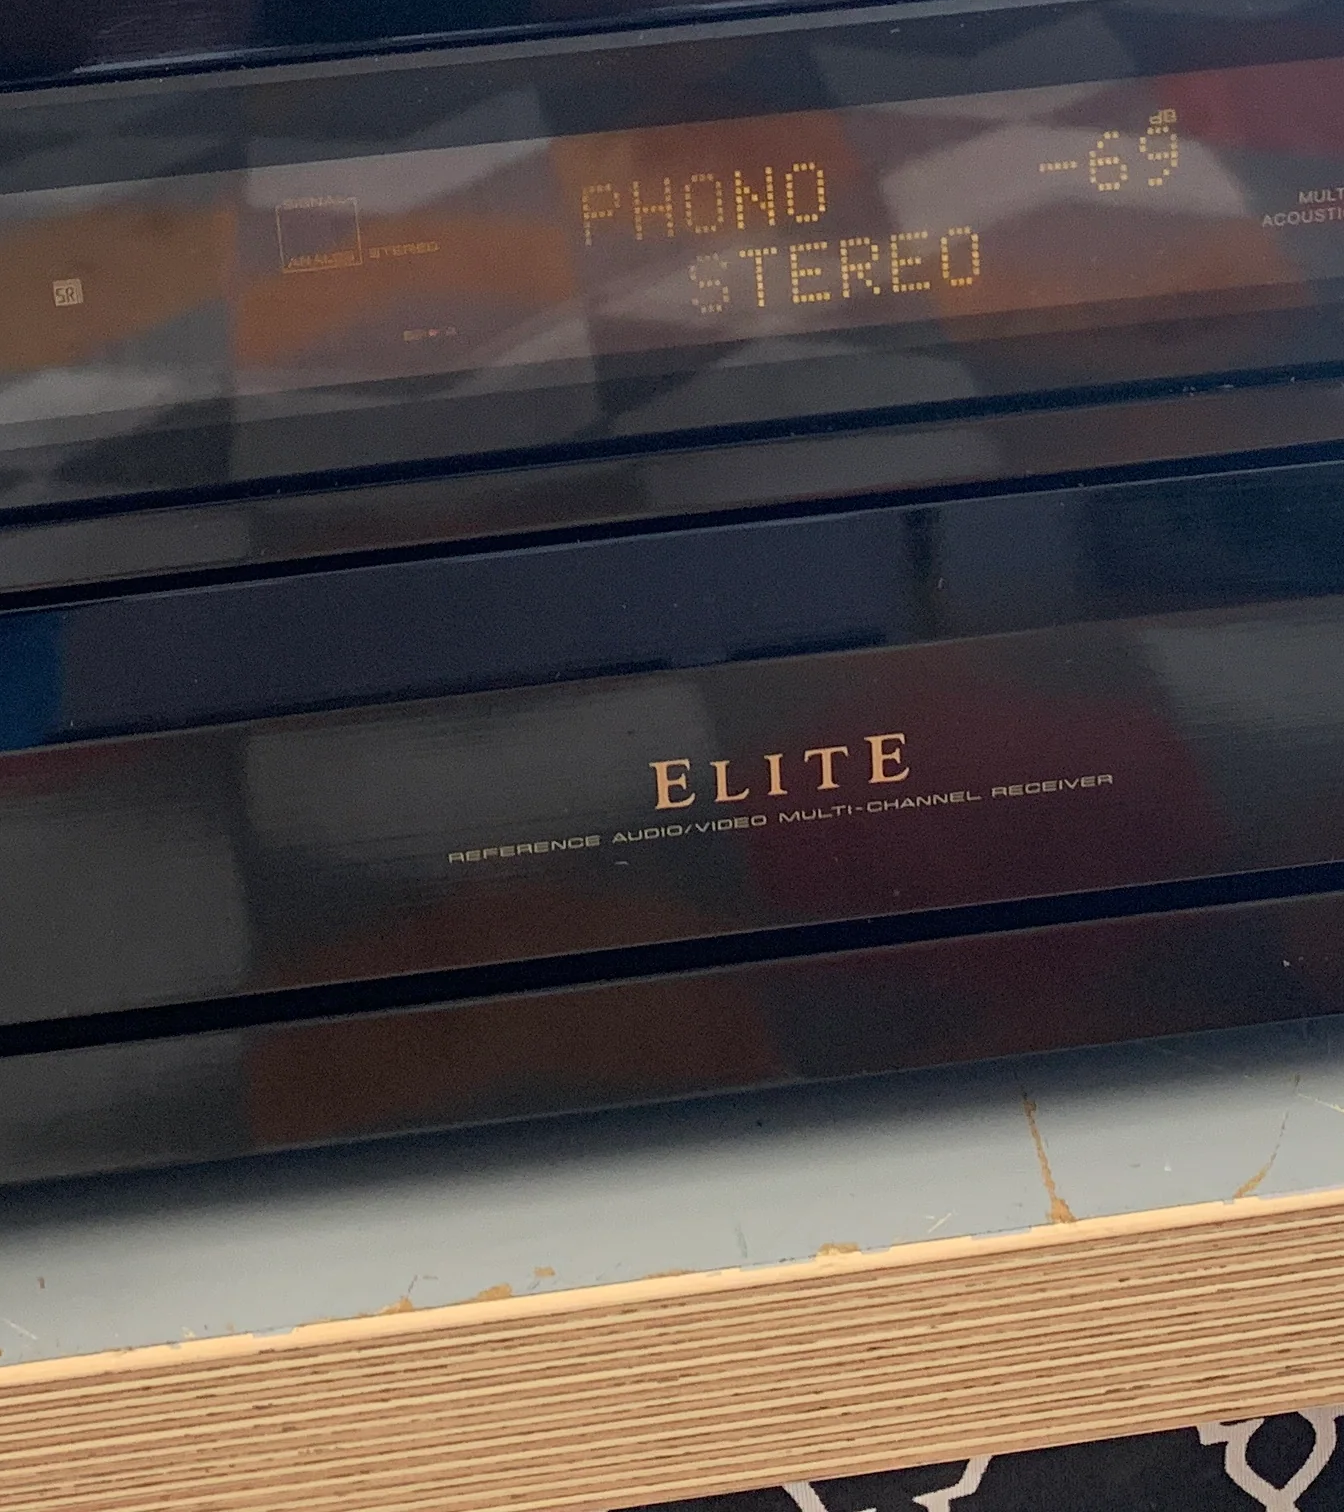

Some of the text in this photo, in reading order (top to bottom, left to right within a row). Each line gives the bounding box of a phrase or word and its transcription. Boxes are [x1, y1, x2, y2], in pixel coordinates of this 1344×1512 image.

[1039, 125, 1178, 191] -69
[580, 161, 829, 247] PHONO
[368, 241, 441, 259] STEREO
[688, 225, 981, 315] STEREO
[647, 731, 912, 811] ELITE
[446, 772, 1114, 864] REFERENCE AUDIO/VIDEO MULTI-CHANNEL RECEIVER
